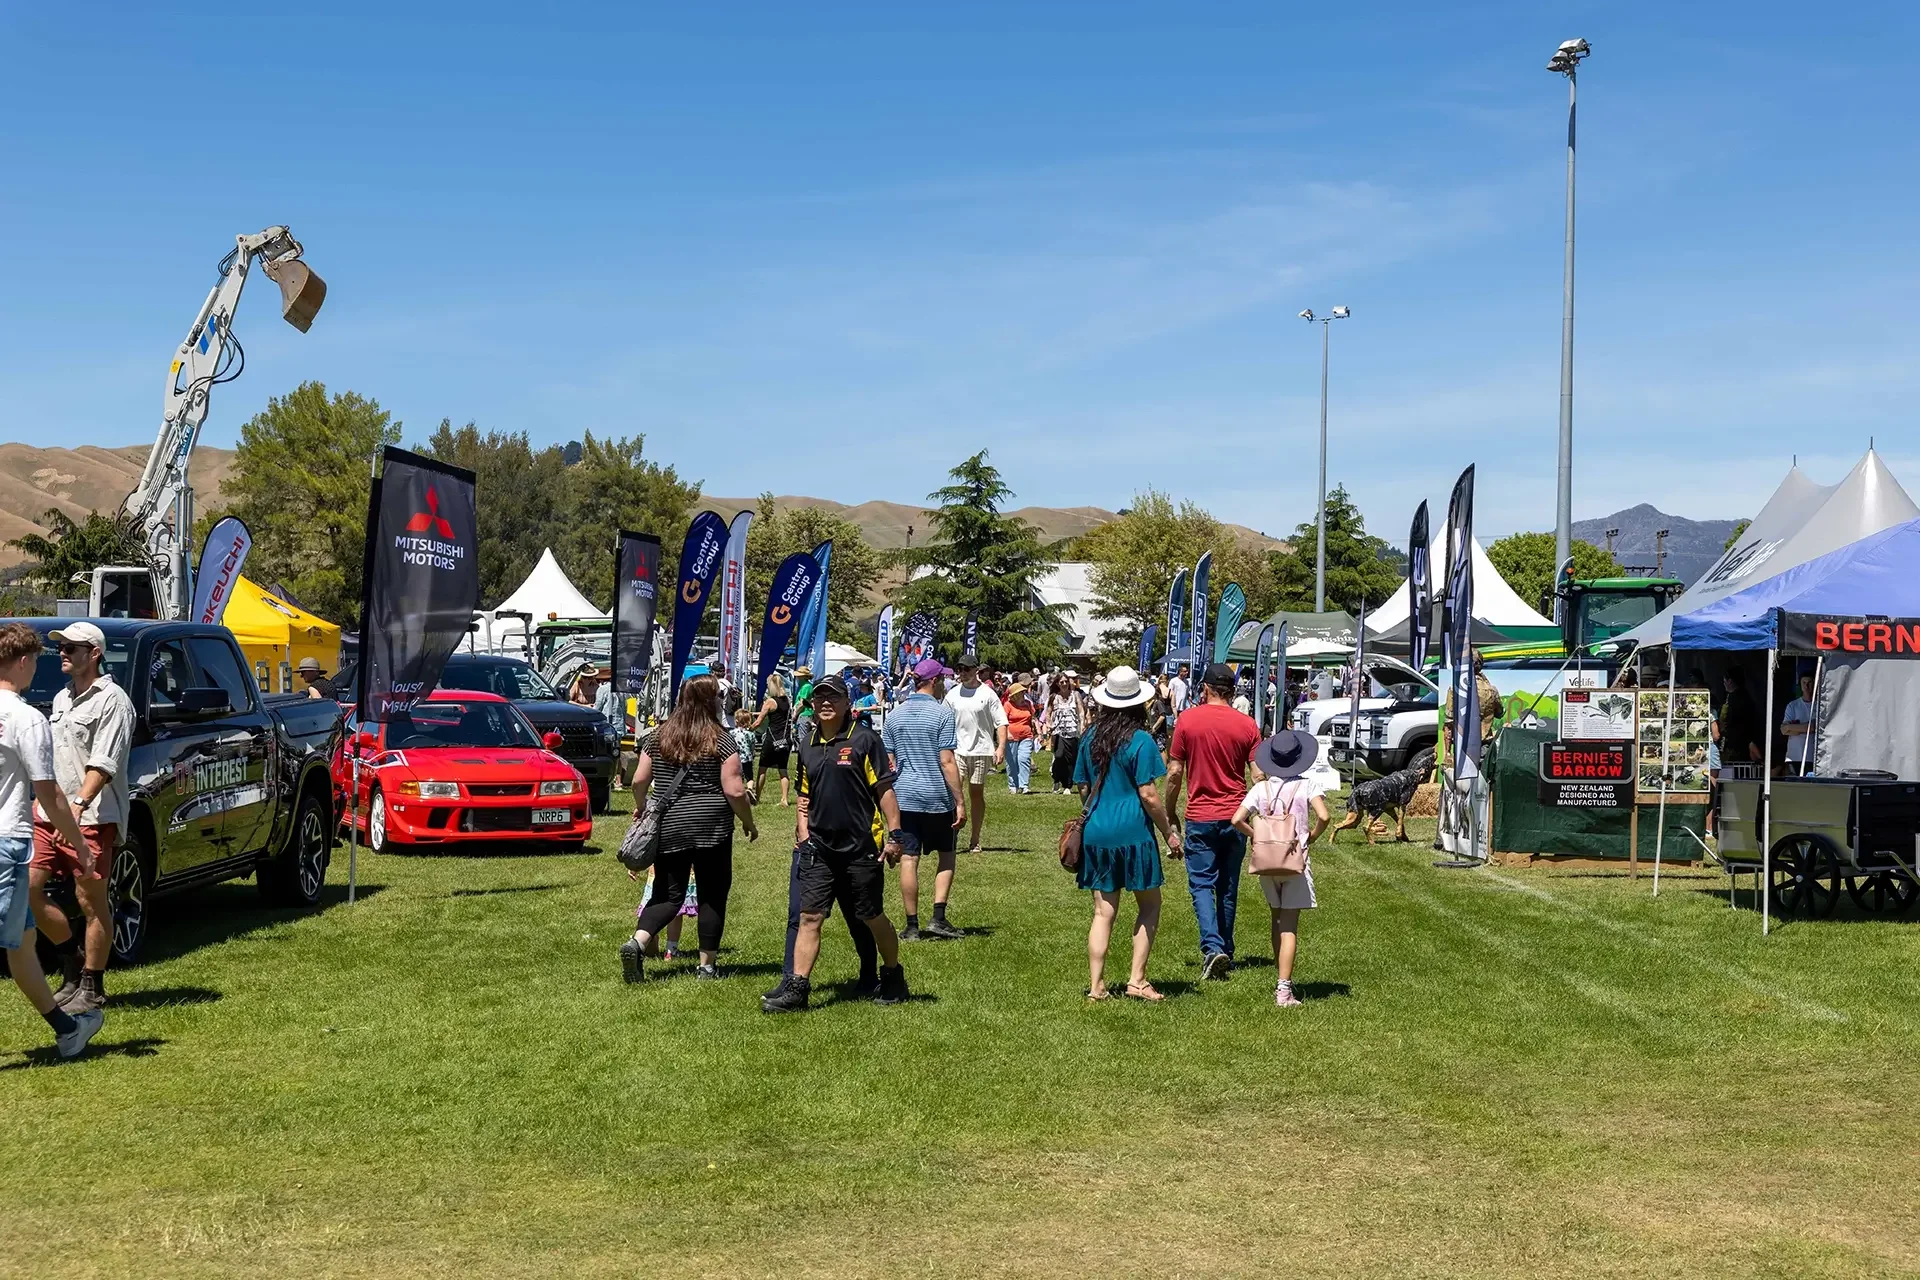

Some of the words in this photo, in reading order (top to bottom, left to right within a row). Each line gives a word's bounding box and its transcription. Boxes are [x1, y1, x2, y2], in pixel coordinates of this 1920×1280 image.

[395, 536, 464, 558] MITSUBISHI
[403, 551, 455, 570] MOTORS
[692, 526, 714, 574] Central
[699, 540, 720, 580] Group
[1704, 538, 1784, 583] Vetlife
[782, 563, 806, 602] Central
[789, 575, 810, 606] Group
[1816, 621, 1920, 654] BERN
[196, 756, 249, 791] INTEREST
[1552, 752, 1623, 764] BERNIE'S
[1553, 765, 1622, 777] BARROW
[539, 811, 564, 822] NRP6
